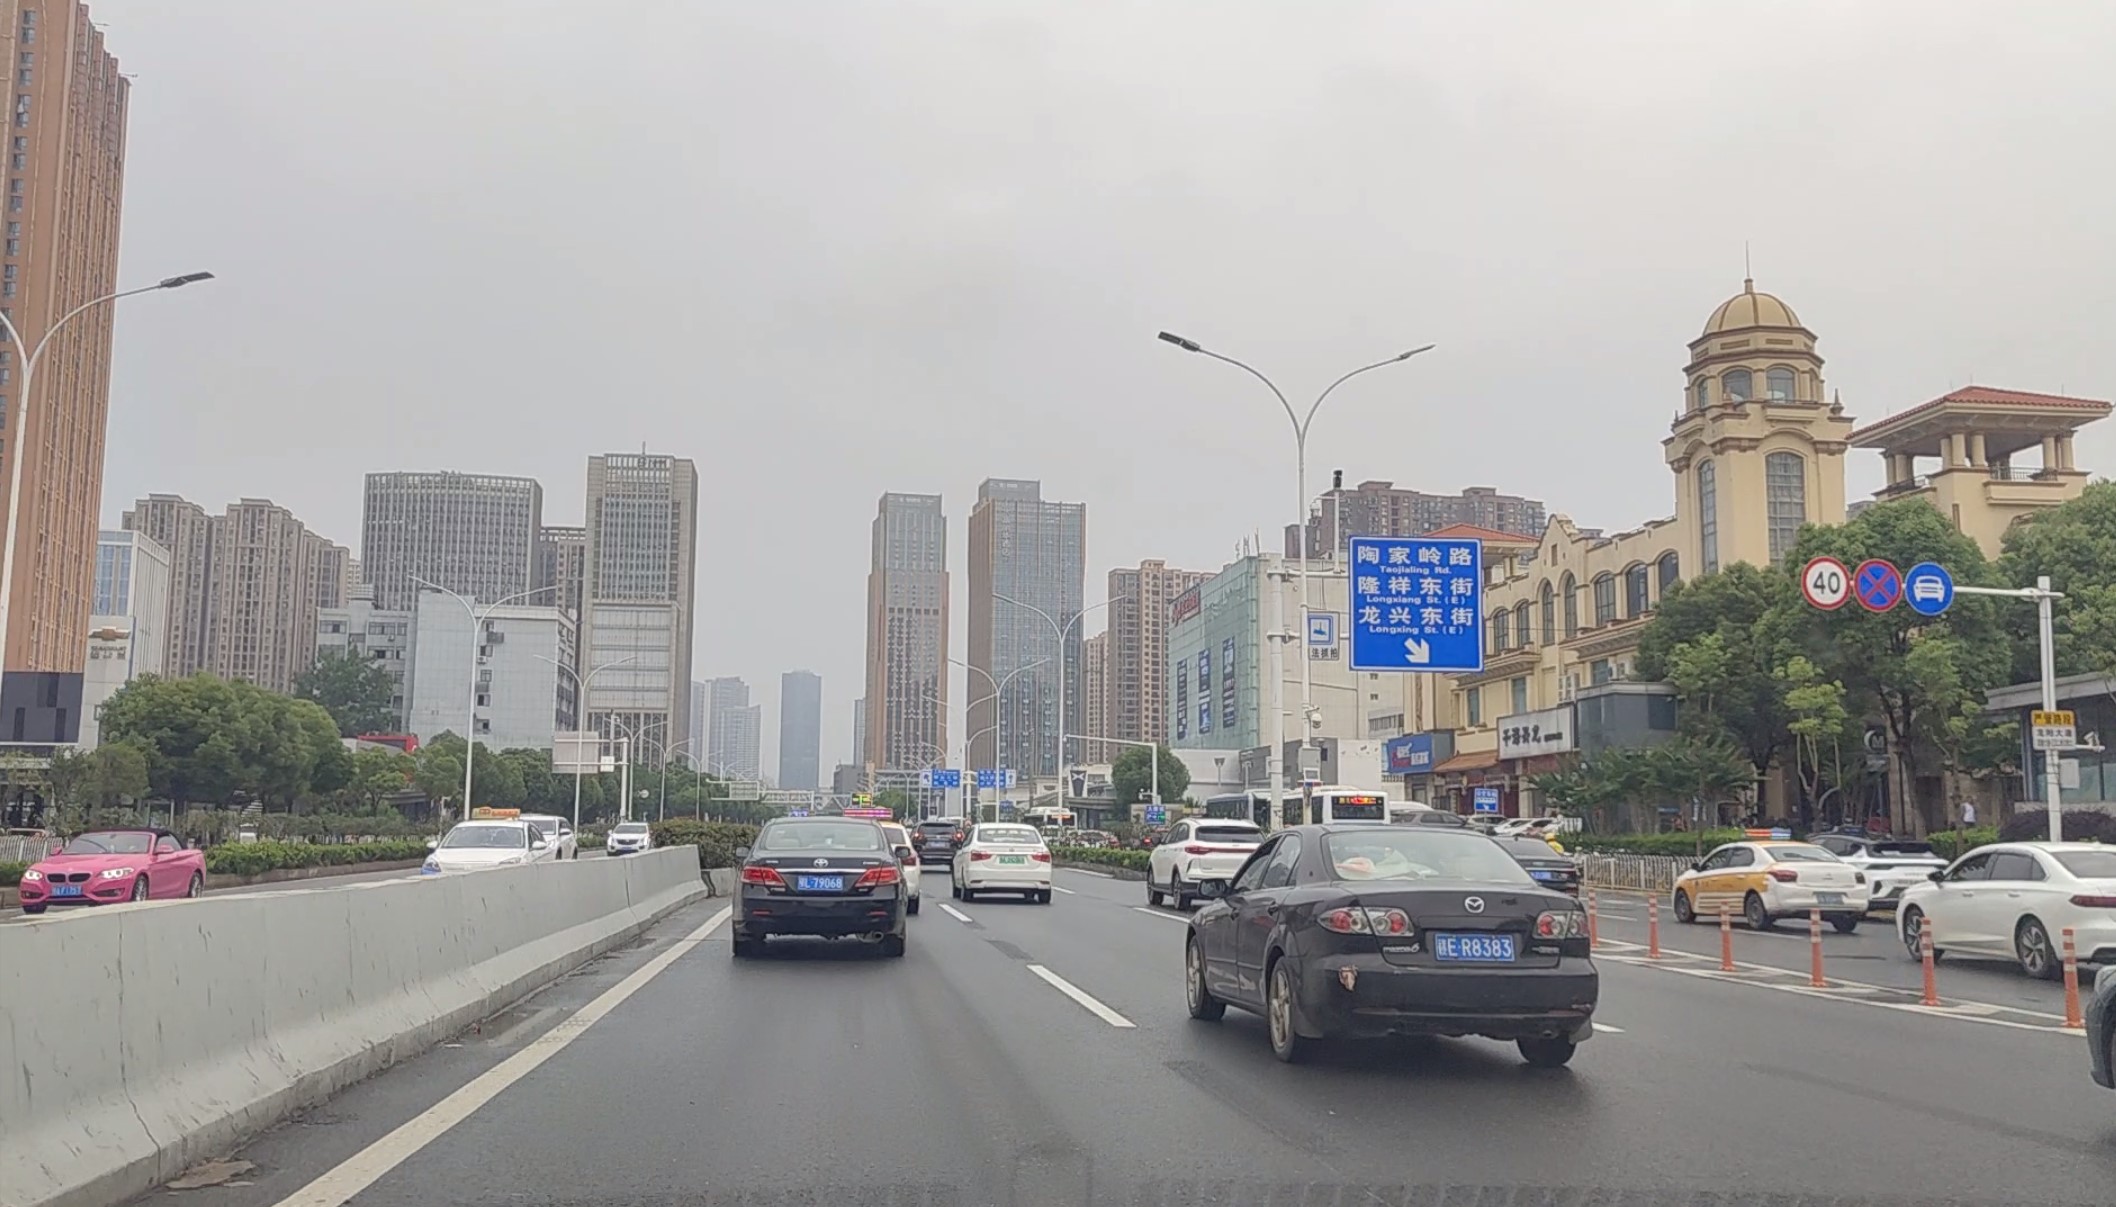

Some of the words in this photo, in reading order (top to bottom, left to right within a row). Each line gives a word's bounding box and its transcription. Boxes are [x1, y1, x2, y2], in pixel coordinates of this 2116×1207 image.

[1357, 545, 1473, 566] 陶家岭路
[1380, 566, 1430, 575] Taojialing
[1434, 566, 1452, 574] Rd.
[1357, 576, 1474, 596] 隆祥东街
[1813, 571, 1840, 594] 40
[1366, 595, 1421, 605] Longxiang
[1426, 596, 1441, 604] St.
[1358, 606, 1474, 626] 龙兴东街
[1369, 625, 1419, 635] Longxing
[1424, 626, 1439, 634] St.
